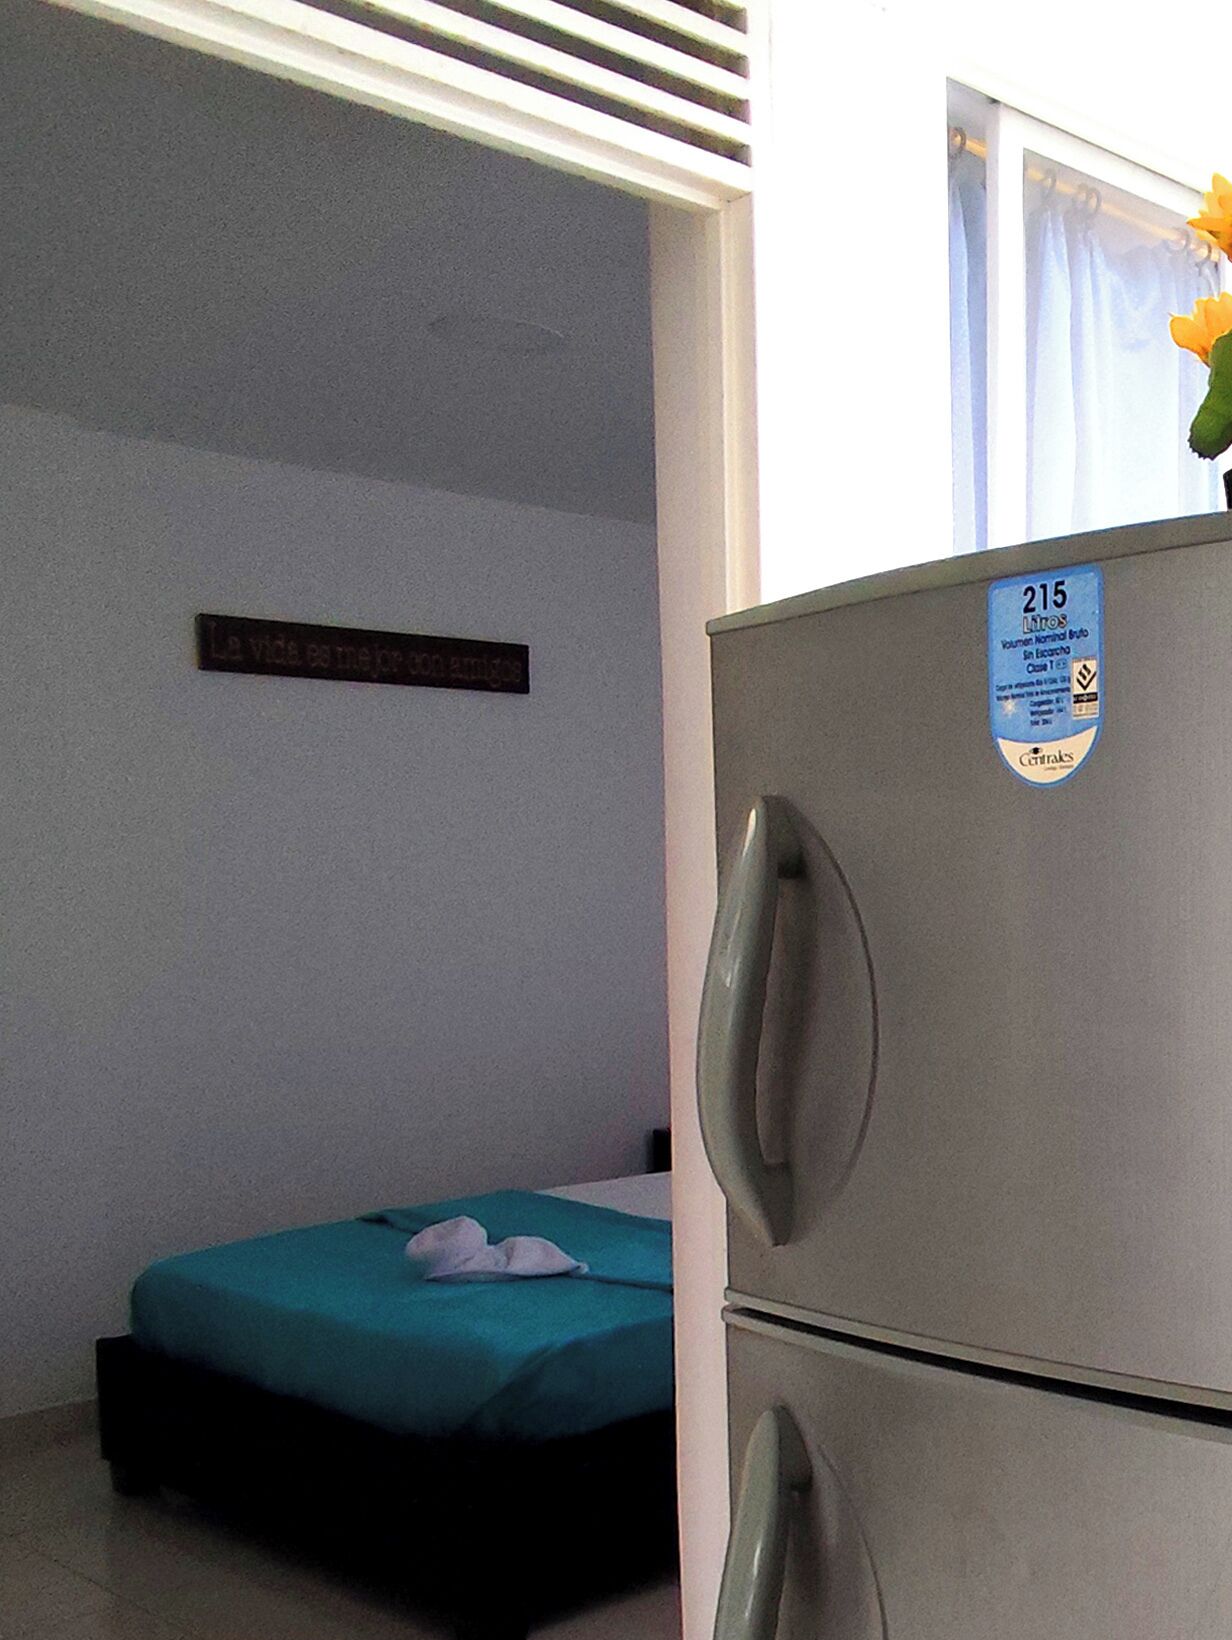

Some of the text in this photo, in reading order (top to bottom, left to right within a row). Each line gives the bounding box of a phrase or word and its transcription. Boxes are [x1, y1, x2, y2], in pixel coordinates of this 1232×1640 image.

[1023, 580, 1067, 613] 215
[1022, 613, 1068, 635] Litros
[1001, 627, 1089, 650] Volumen Nominal Bruto
[1019, 749, 1074, 767] Centrales
